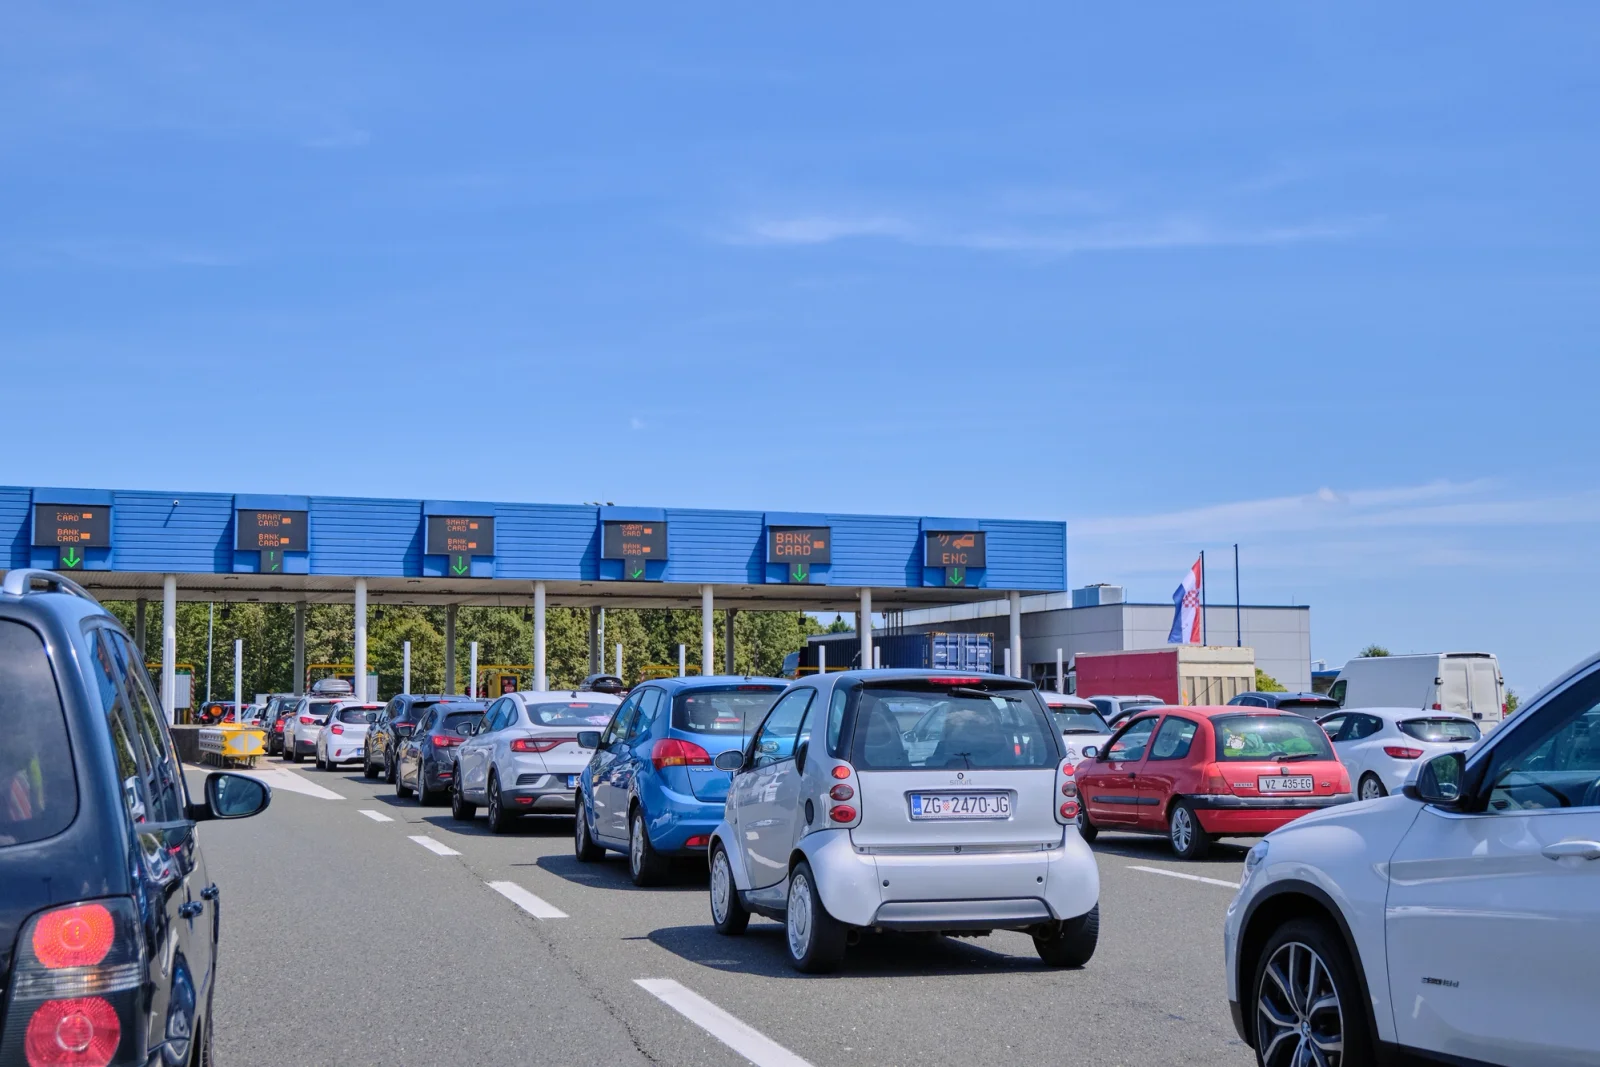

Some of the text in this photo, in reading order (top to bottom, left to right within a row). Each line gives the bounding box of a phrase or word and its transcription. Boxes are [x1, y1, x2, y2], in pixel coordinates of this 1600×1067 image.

[776, 533, 811, 544] BANK
[776, 545, 811, 556] CARD
[942, 553, 968, 564] ENC
[1265, 780, 1276, 790] VZ
[1282, 778, 1311, 789] 435-EG
[922, 797, 941, 814] ZG
